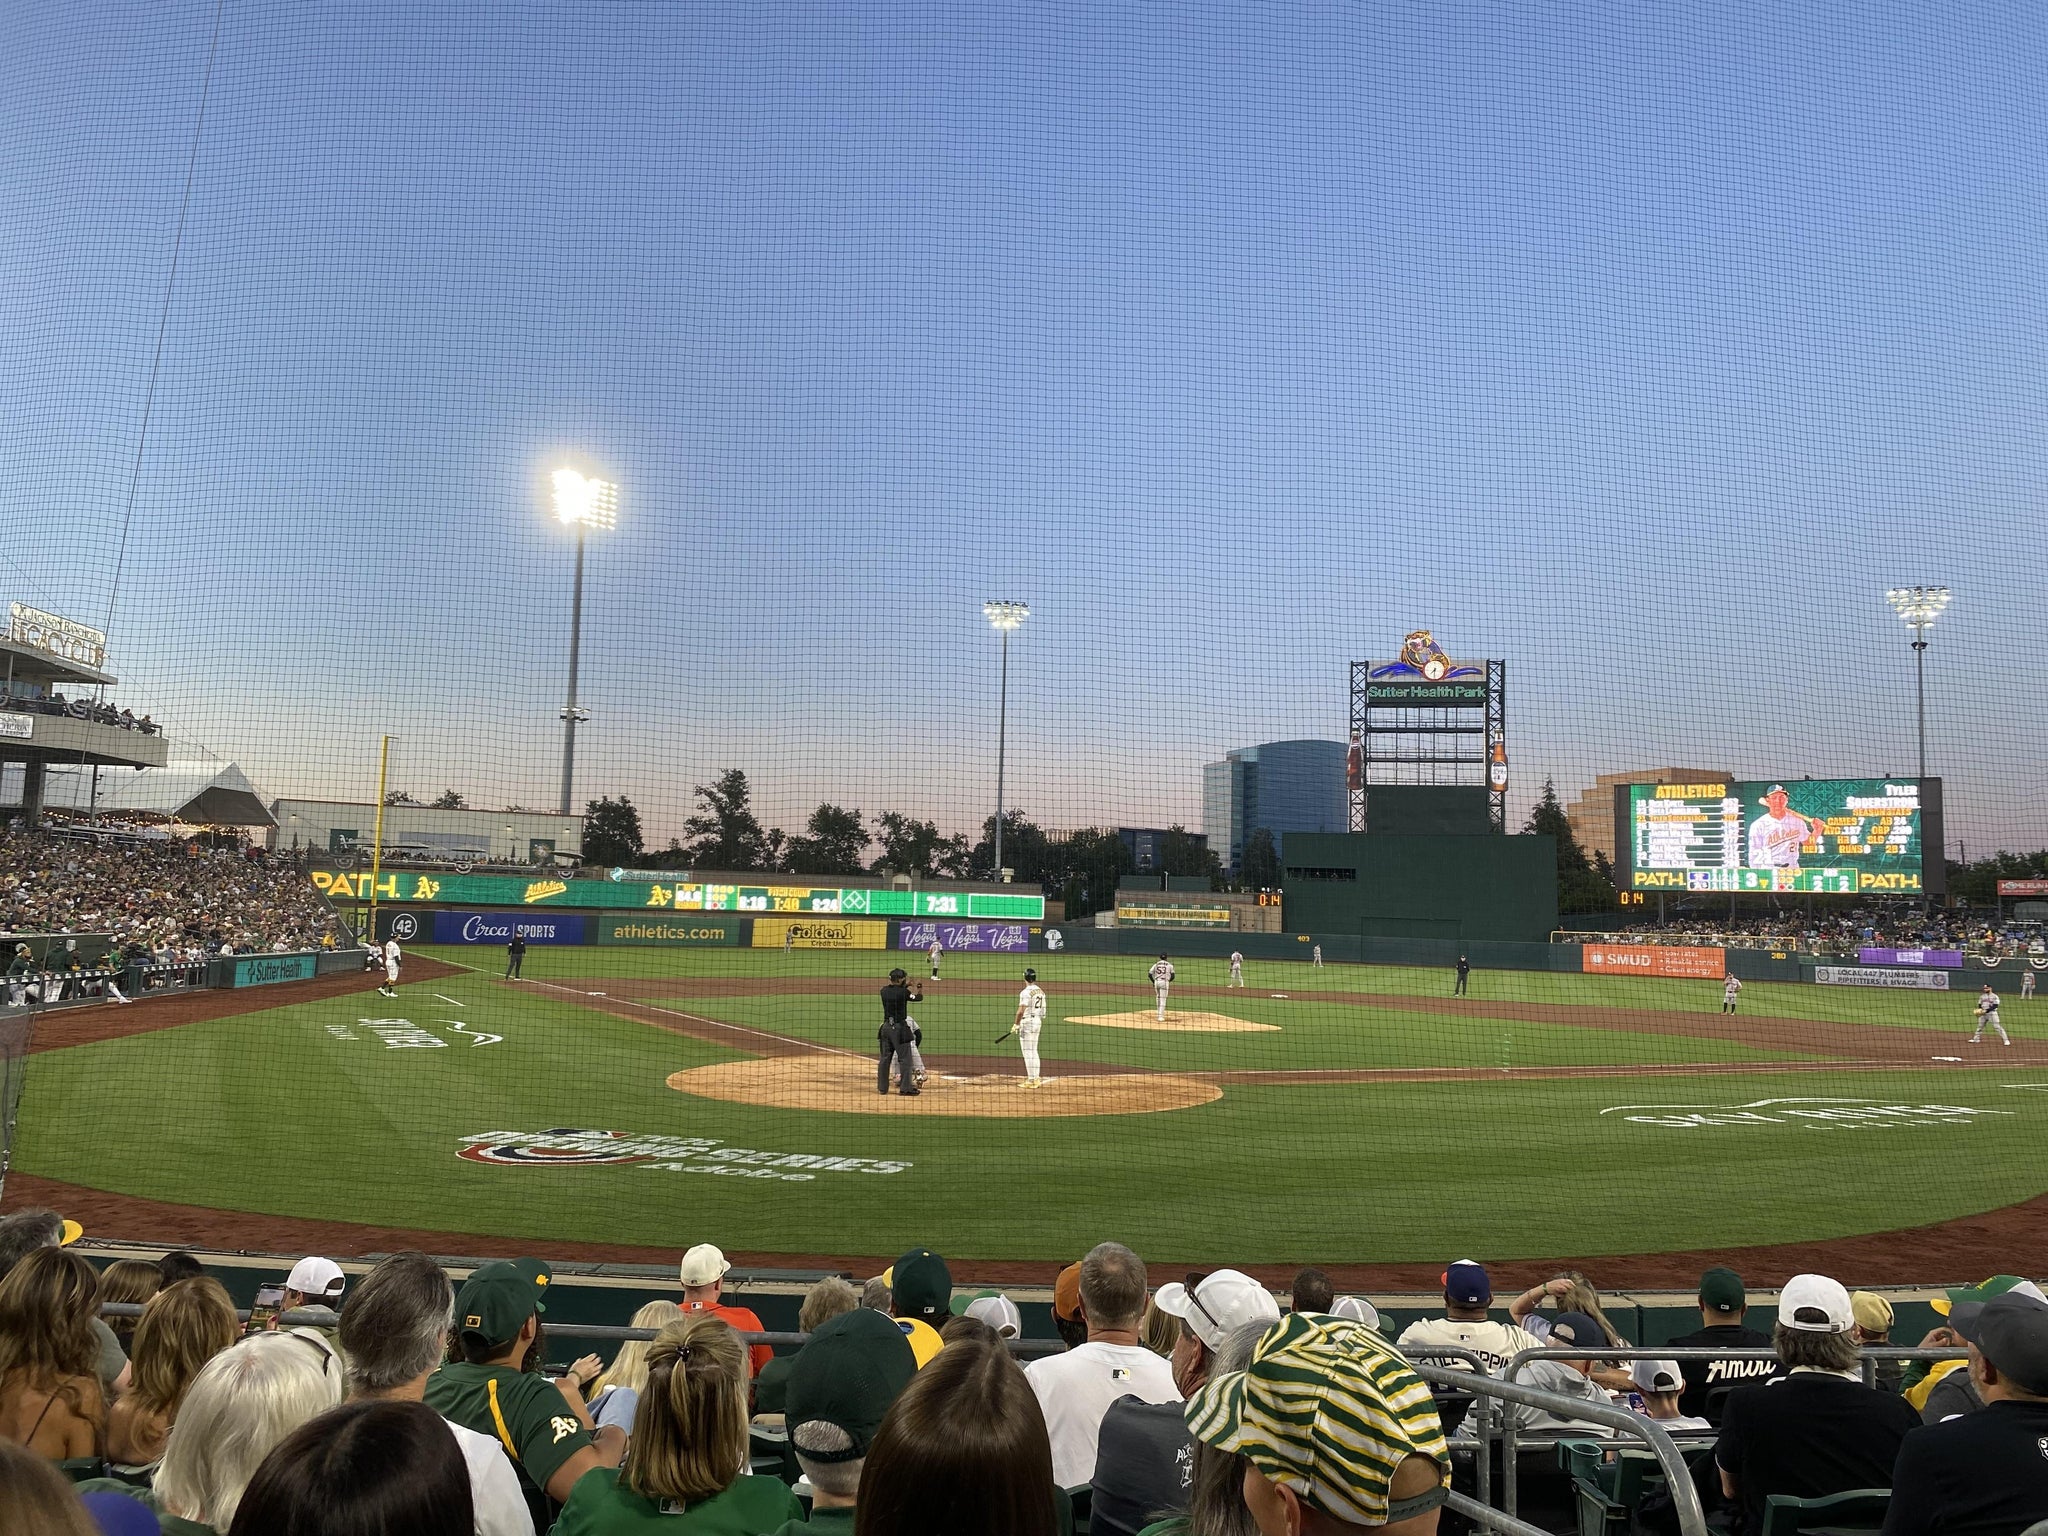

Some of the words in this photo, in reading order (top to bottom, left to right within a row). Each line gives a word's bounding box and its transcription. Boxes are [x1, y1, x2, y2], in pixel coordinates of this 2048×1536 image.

[1368, 686, 1410, 698] Sutter
[1410, 686, 1454, 698] Health
[1455, 686, 1487, 698] Park
[1655, 784, 1726, 798] ATHLETICS
[1885, 784, 1918, 796] TYLER
[624, 870, 657, 881] Sutter
[659, 871, 690, 882] Health
[1745, 872, 1758, 888] 3
[412, 876, 440, 899] A's
[647, 885, 672, 906] A's
[926, 896, 959, 913] 7:31
[1259, 894, 1281, 907] 0:14
[1621, 892, 1644, 905] 0:14
[396, 920, 412, 933] 42
[462, 915, 510, 941] Circa
[516, 924, 556, 939] SPORTS
[613, 924, 725, 940] athletics.com
[900, 926, 938, 949] Vegas
[943, 926, 985, 950] Vegas
[986, 927, 1028, 950] Vegas
[1607, 953, 1652, 967] SMUD
[256, 960, 280, 982] Sutter
[280, 957, 302, 979] Health
[1156, 966, 1167, 975] 53
[1837, 969, 1861, 977] LOCAL
[1034, 996, 1043, 1009] 21
[1623, 1111, 1787, 1128] SKY
[1776, 1104, 2017, 1120] RIVER
[457, 1130, 711, 1158] OPENING
[692, 1147, 915, 1174] SERIES
[635, 1162, 817, 1181] Adobe
[551, 1416, 578, 1444] A's
